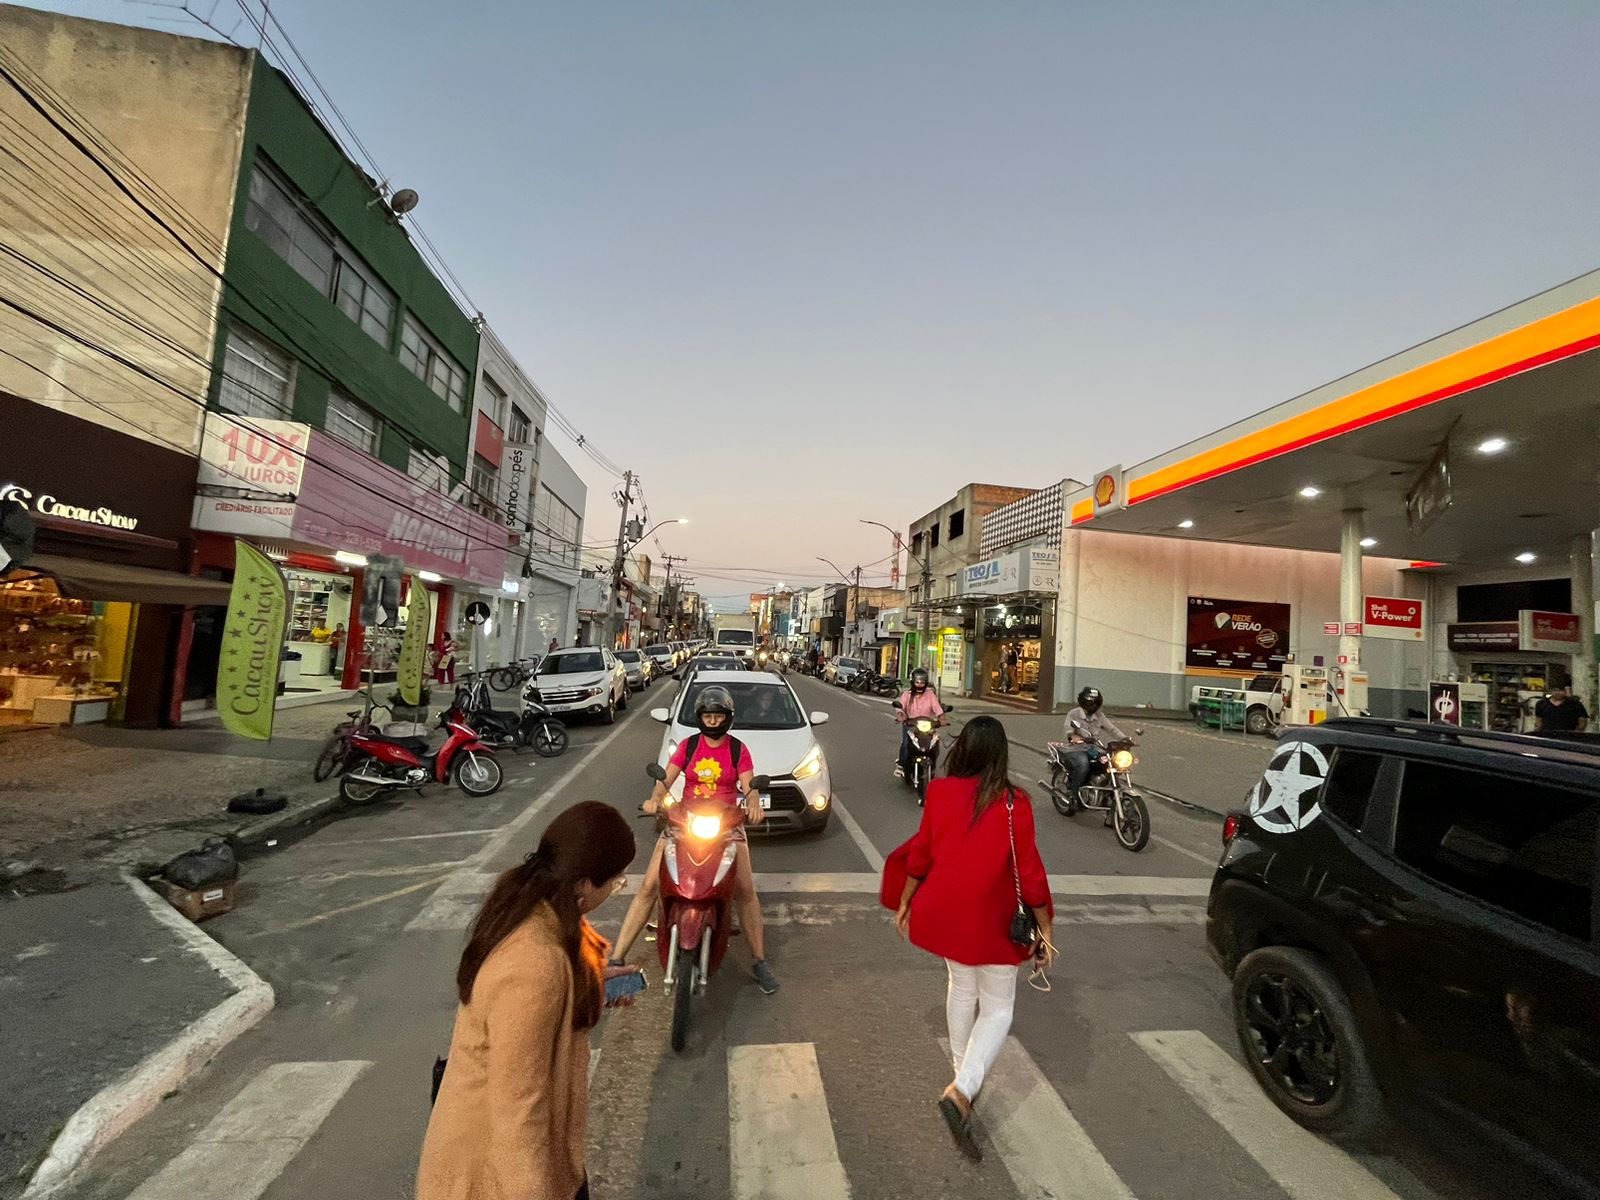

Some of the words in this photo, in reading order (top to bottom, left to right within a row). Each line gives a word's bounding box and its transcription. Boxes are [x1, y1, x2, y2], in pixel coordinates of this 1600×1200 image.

[222, 427, 301, 468] 10X
[244, 466, 298, 485] JUROS
[1371, 604, 1388, 612] Shell
[1371, 610, 1413, 622] V-Power
